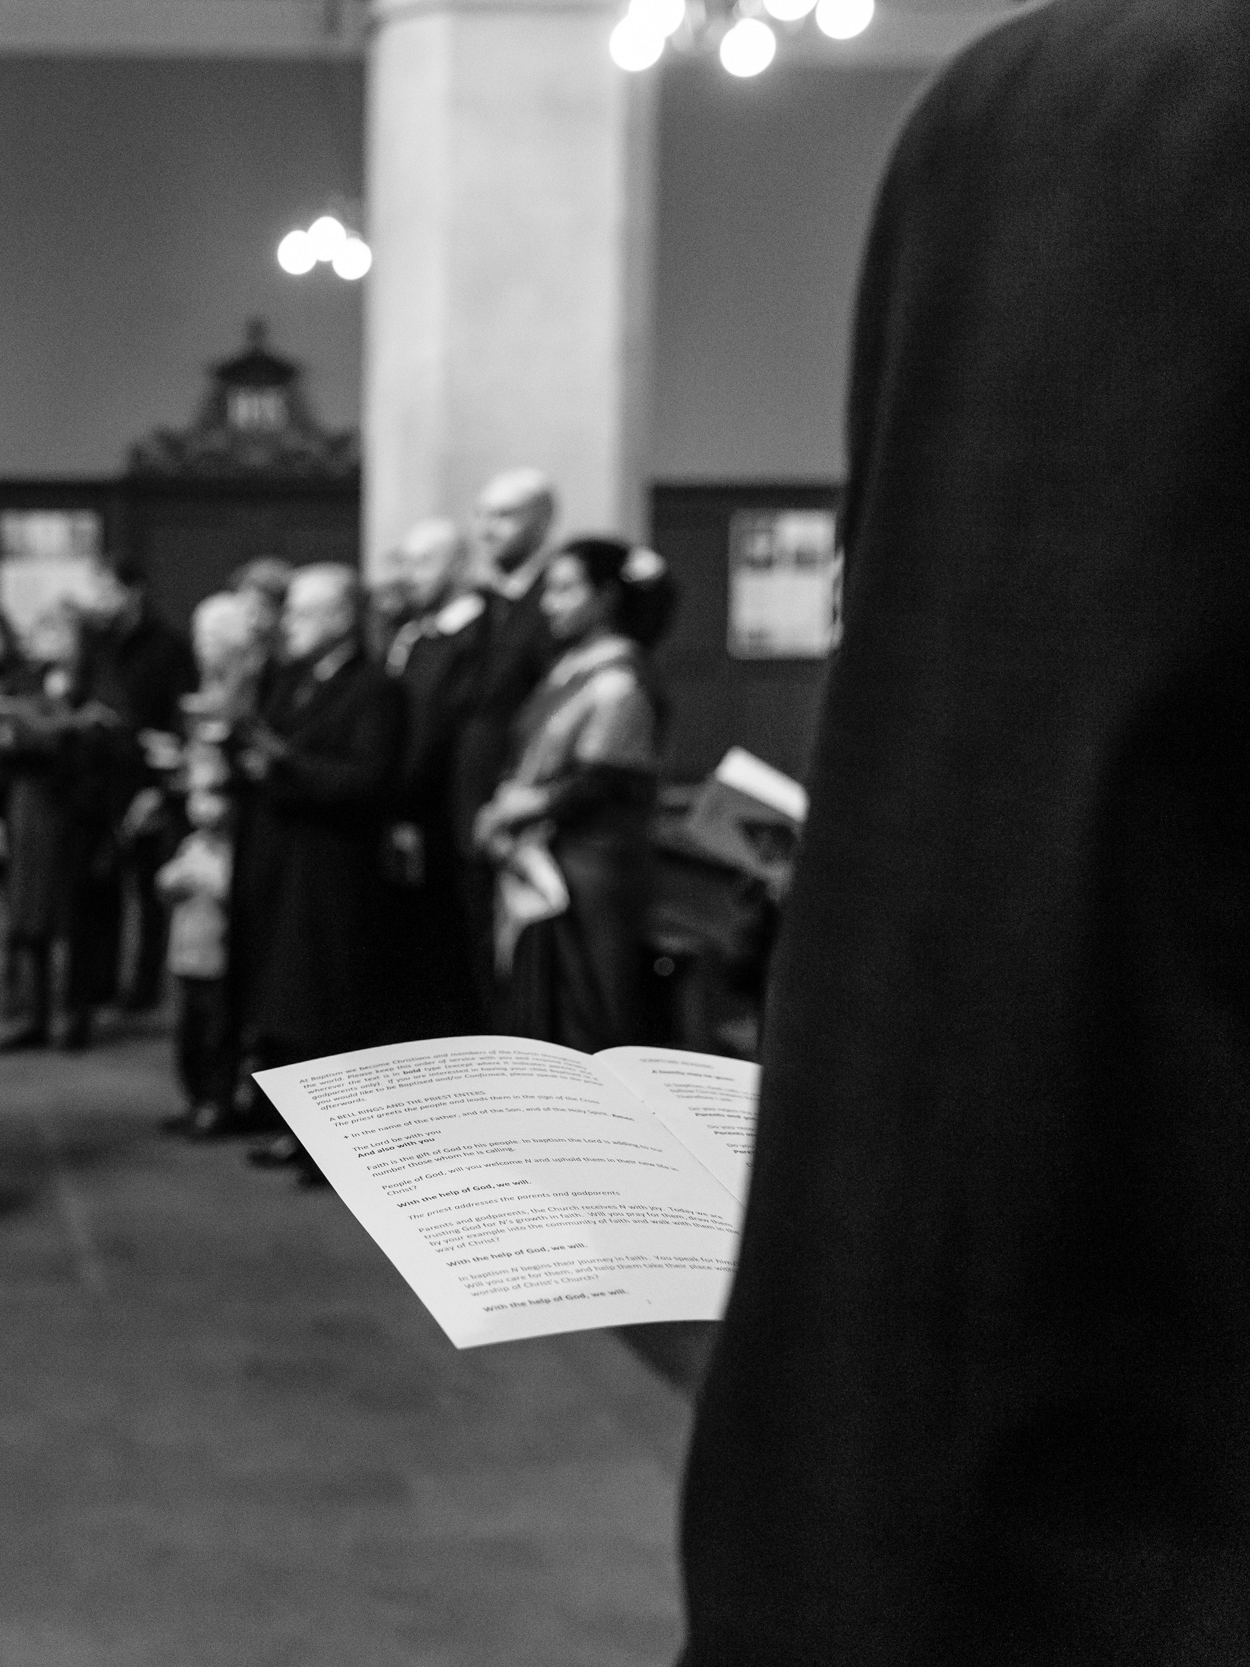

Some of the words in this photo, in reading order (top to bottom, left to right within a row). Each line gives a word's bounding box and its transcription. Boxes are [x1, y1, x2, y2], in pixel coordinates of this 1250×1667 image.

[351, 1114, 373, 1124] priest
[376, 1110, 402, 1118] greets
[419, 1102, 446, 1110] people
[357, 1106, 384, 1114] RINGS
[370, 1139, 389, 1147] Lord
[366, 1162, 389, 1170] Faith
[372, 1165, 405, 1177] number
[407, 1159, 432, 1167] those
[381, 1180, 412, 1190] People
[386, 1185, 416, 1195] Christ?
[396, 1199, 420, 1207] With
[426, 1206, 451, 1216] priest
[454, 1199, 498, 1209] addresses
[418, 1222, 453, 1232] Parents
[423, 1228, 460, 1239] trusting
[515, 1215, 548, 1223] growth
[466, 1228, 505, 1238] example
[468, 1236, 499, 1246] Christ?
[469, 1269, 509, 1279] baptism
[470, 1286, 509, 1296] worship
[523, 1279, 559, 1288] Christ's
